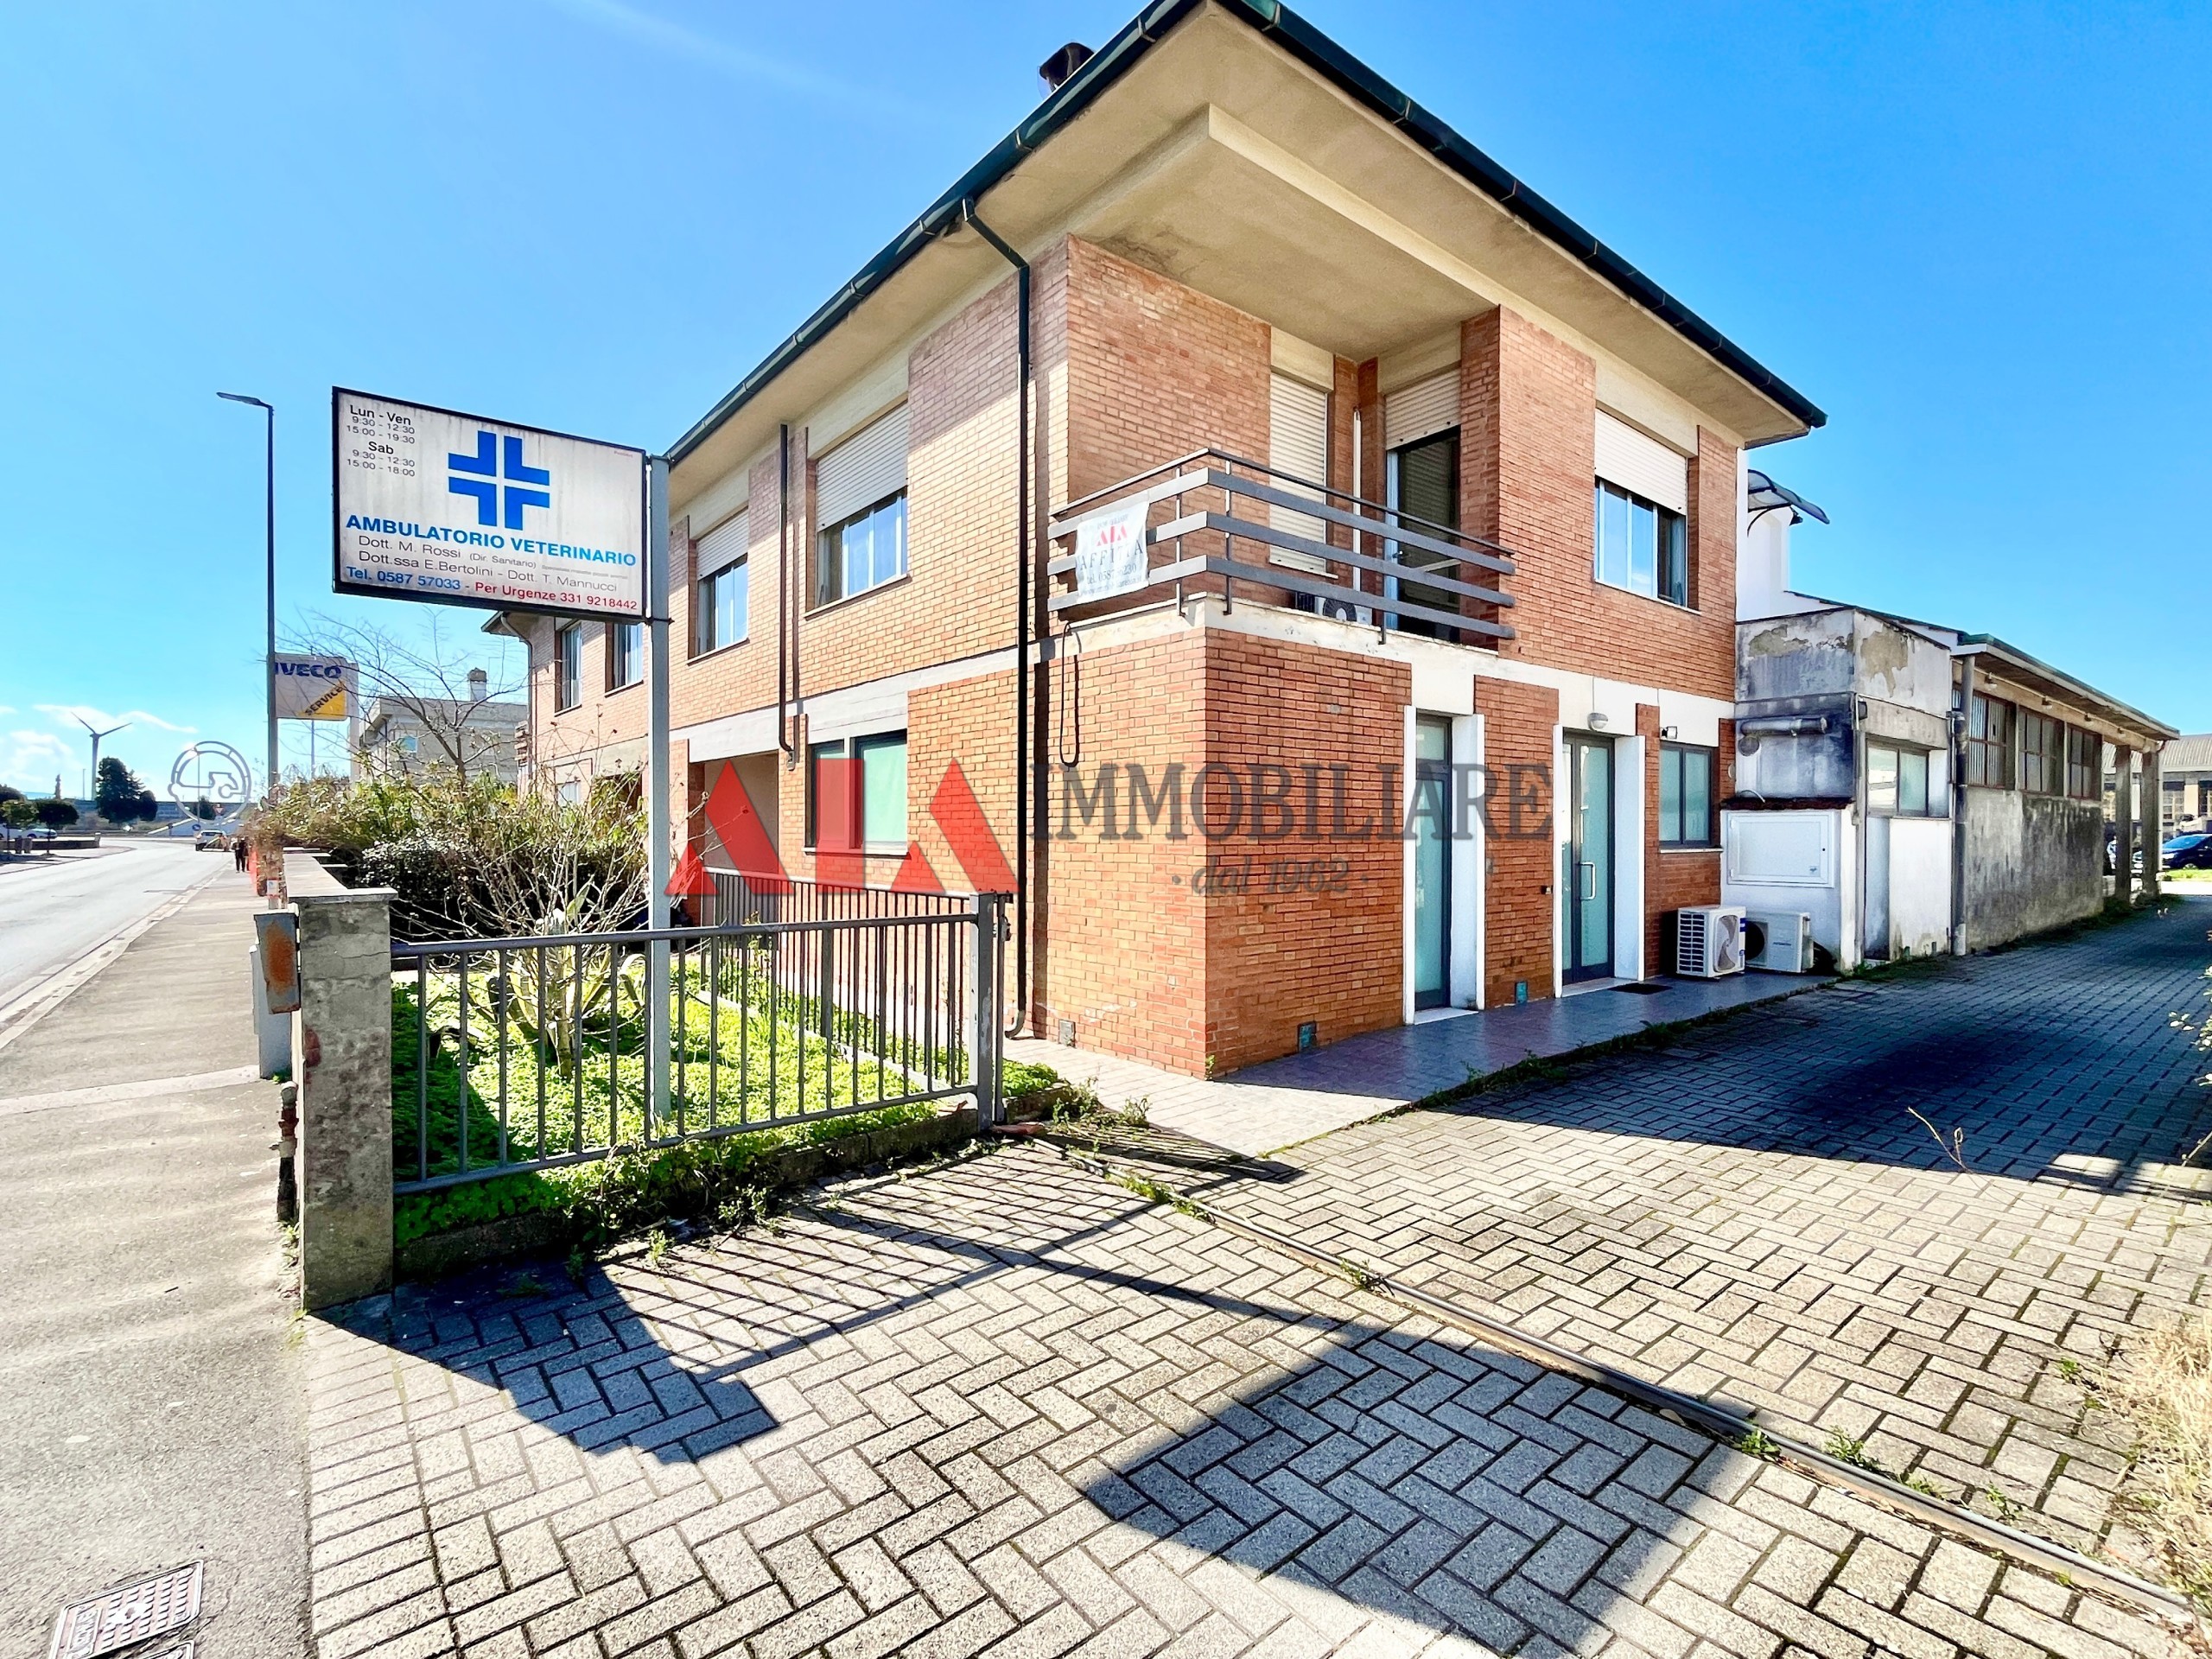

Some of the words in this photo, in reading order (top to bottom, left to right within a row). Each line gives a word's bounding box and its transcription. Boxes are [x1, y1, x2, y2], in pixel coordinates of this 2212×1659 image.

[350, 405, 375, 418] Lun
[387, 412, 411, 425] Ven
[346, 425, 375, 436] 15:00
[387, 433, 415, 444] 19:30
[353, 416, 375, 427] 9:30
[387, 423, 415, 434] 12:30
[368, 441, 394, 454] Sab
[346, 459, 375, 469] 15:00
[387, 466, 415, 476] 18:00
[353, 449, 375, 460] 9:30
[387, 456, 415, 467] 12:30
[346, 514, 505, 549] AMBULATORIO
[511, 537, 637, 566] VETERINARIO
[359, 535, 392, 550] Dott.
[398, 541, 416, 552] M.
[423, 544, 461, 558] Rossi
[469, 553, 487, 562] (Dir.
[492, 556, 537, 569] Sanitario)
[359, 550, 419, 568] Dott.ssa
[424, 559, 493, 576] E.Bertolini
[507, 569, 537, 582] Dott.
[543, 574, 552, 585] T.
[556, 575, 617, 592] Mannucci
[346, 566, 372, 580] Tel.
[377, 570, 413, 584] 0587
[417, 575, 461, 590] 57033
[475, 582, 498, 594] Per
[502, 585, 556, 601] Urgenze
[560, 592, 582, 603] 331
[587, 595, 638, 609] 9218442
[274, 662, 342, 678] IVECO
[305, 685, 343, 715] SERVICE
